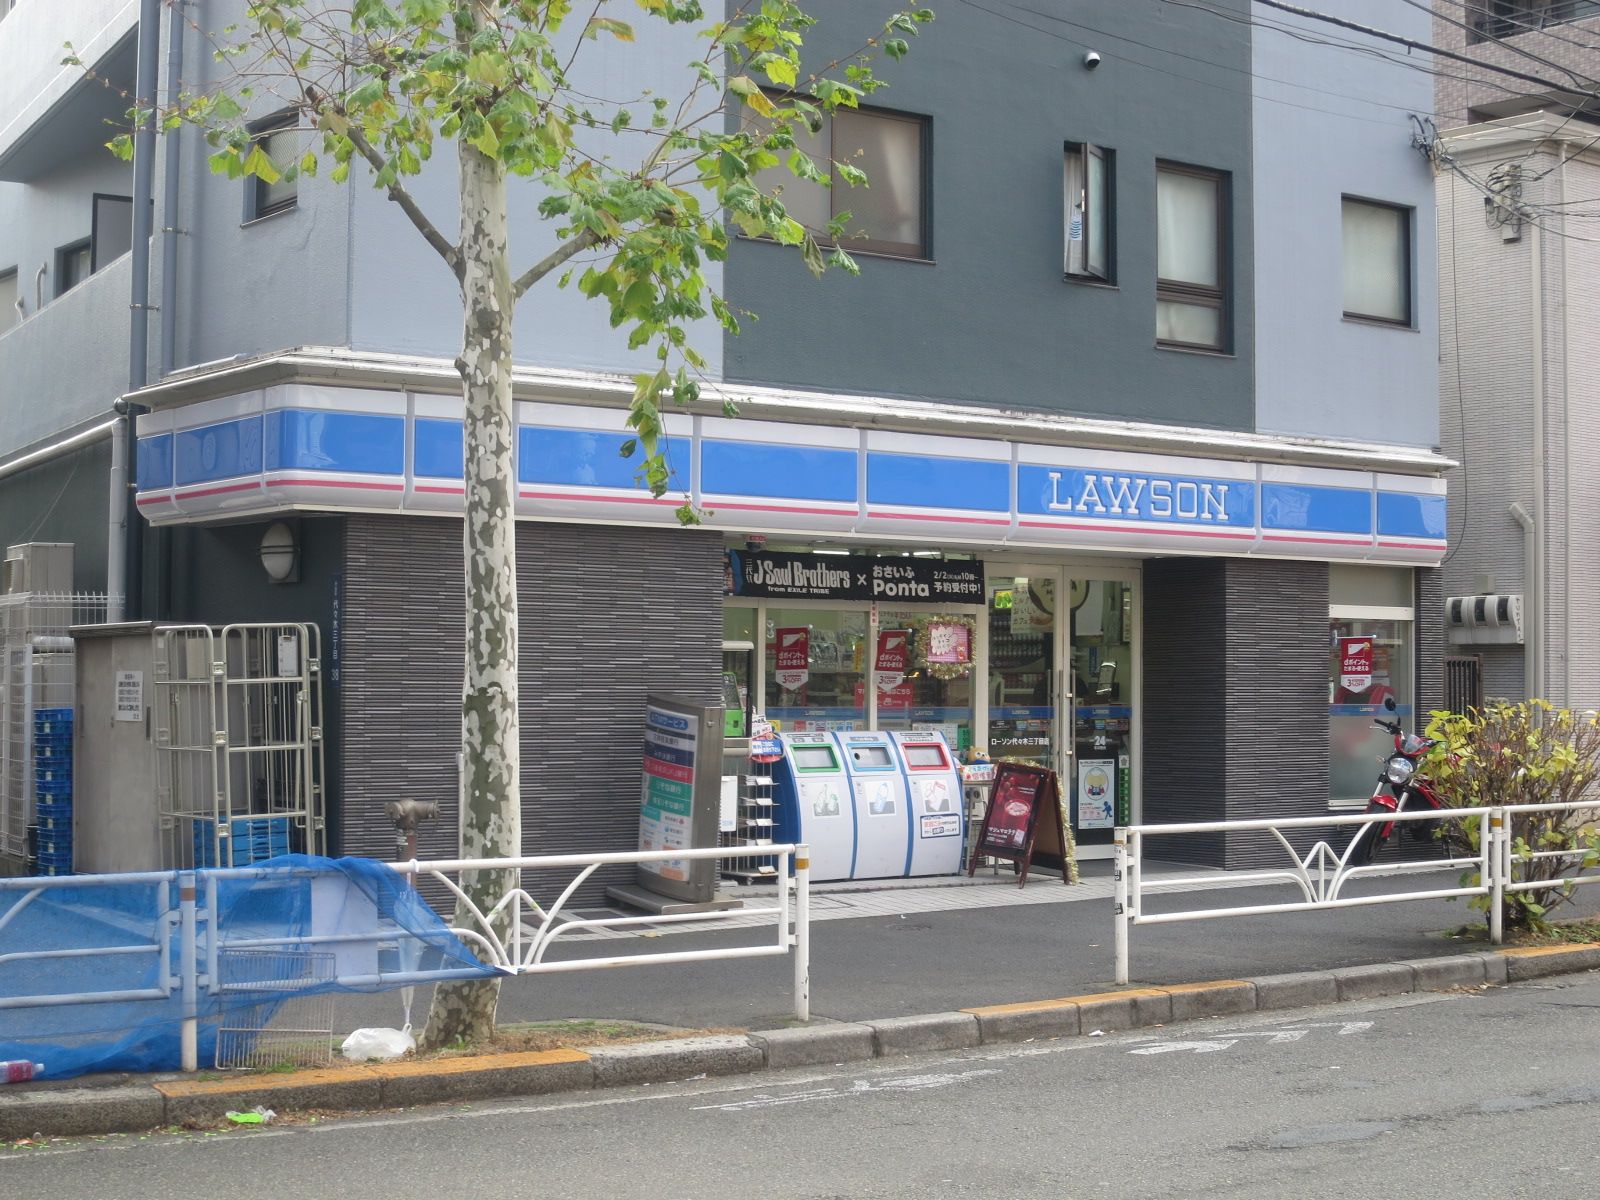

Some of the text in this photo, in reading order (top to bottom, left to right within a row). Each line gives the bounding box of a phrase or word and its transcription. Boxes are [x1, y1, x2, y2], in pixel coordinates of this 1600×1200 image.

[1049, 472, 1229, 520] LAWSON
[754, 560, 763, 585] J
[763, 560, 792, 586] Soul
[793, 562, 850, 588] Brothers
[873, 565, 915, 579] おさいふ
[873, 579, 930, 597] Ponta
[991, 737, 1050, 746] ローソン代々木三丁目店
[1094, 735, 1106, 746] 24
